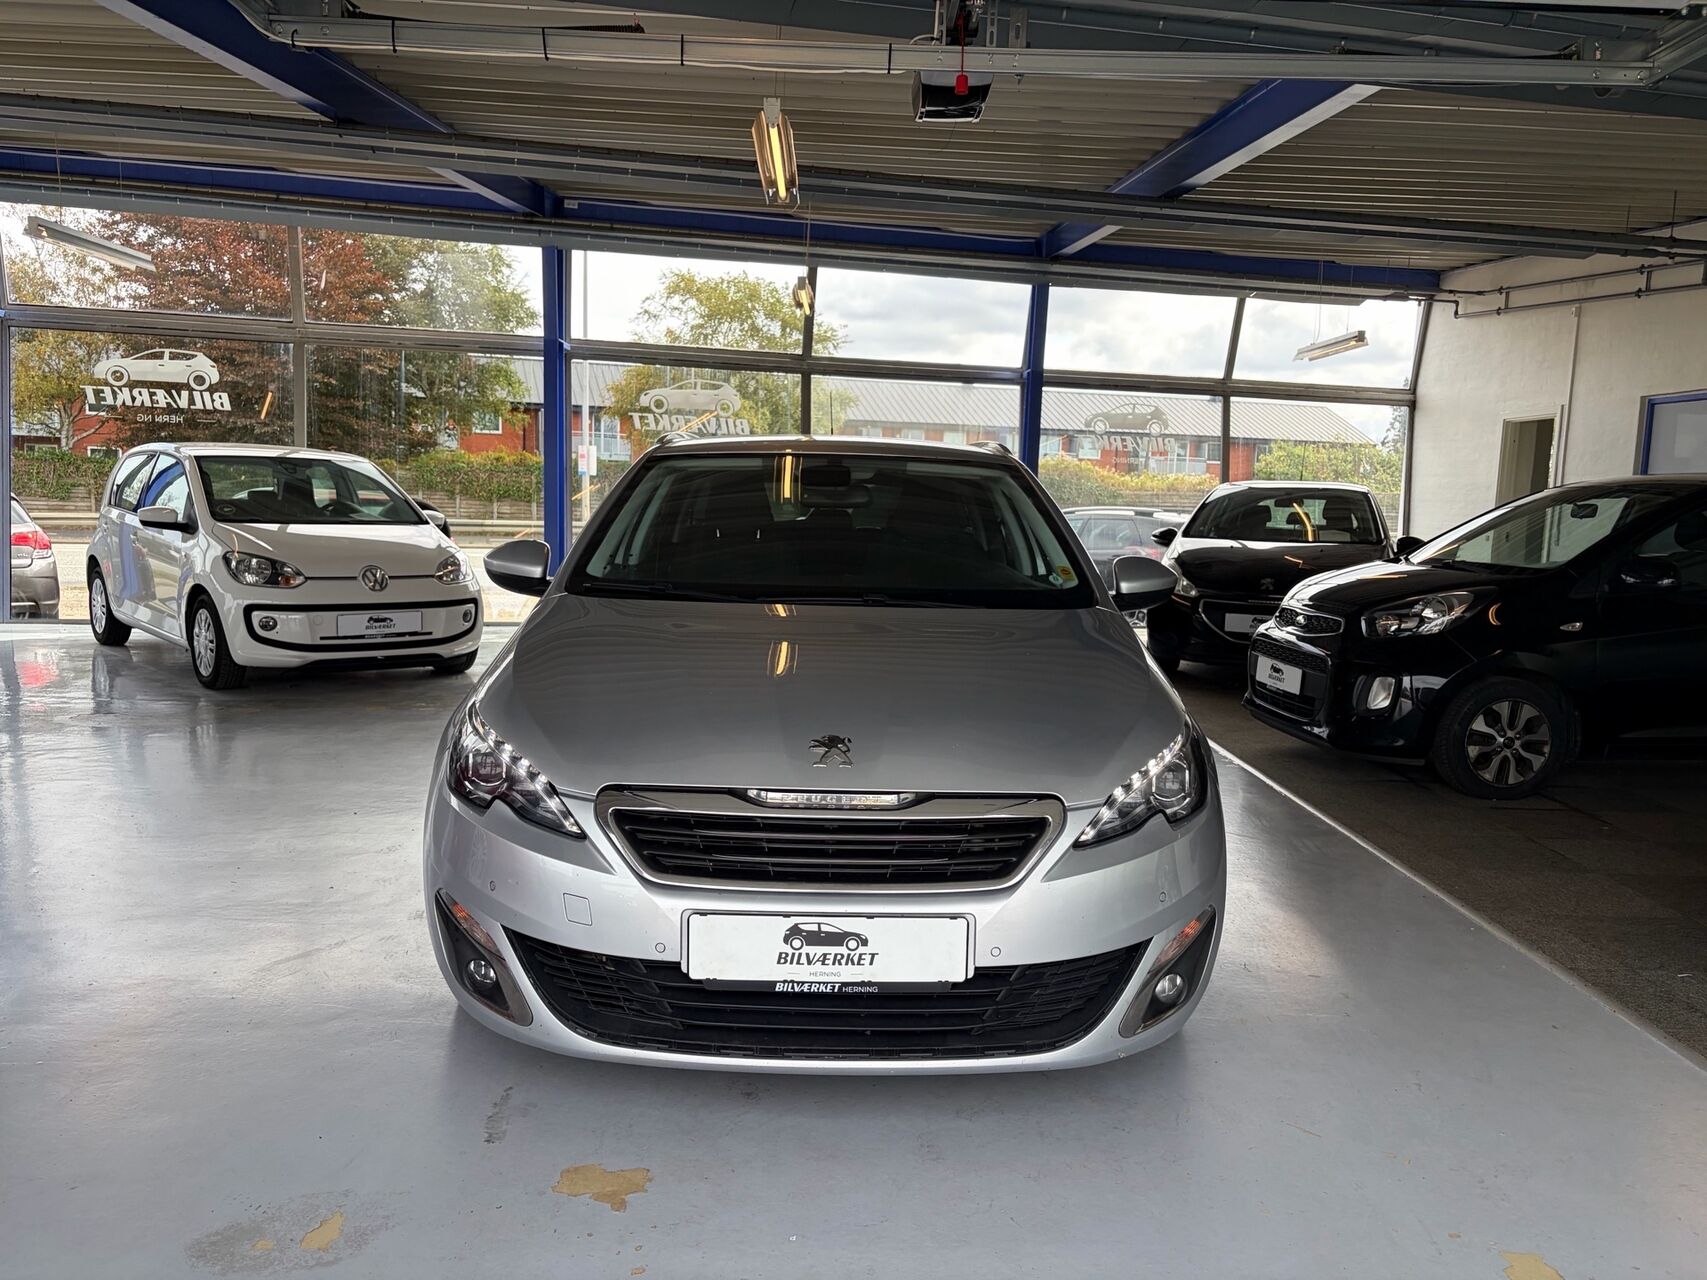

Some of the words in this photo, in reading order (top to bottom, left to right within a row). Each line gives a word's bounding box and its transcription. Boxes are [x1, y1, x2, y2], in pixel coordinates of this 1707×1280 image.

[776, 951, 879, 966] BILVÆRKET
[809, 970, 841, 978] HERNING
[775, 982, 841, 993] BILVÆRKET
